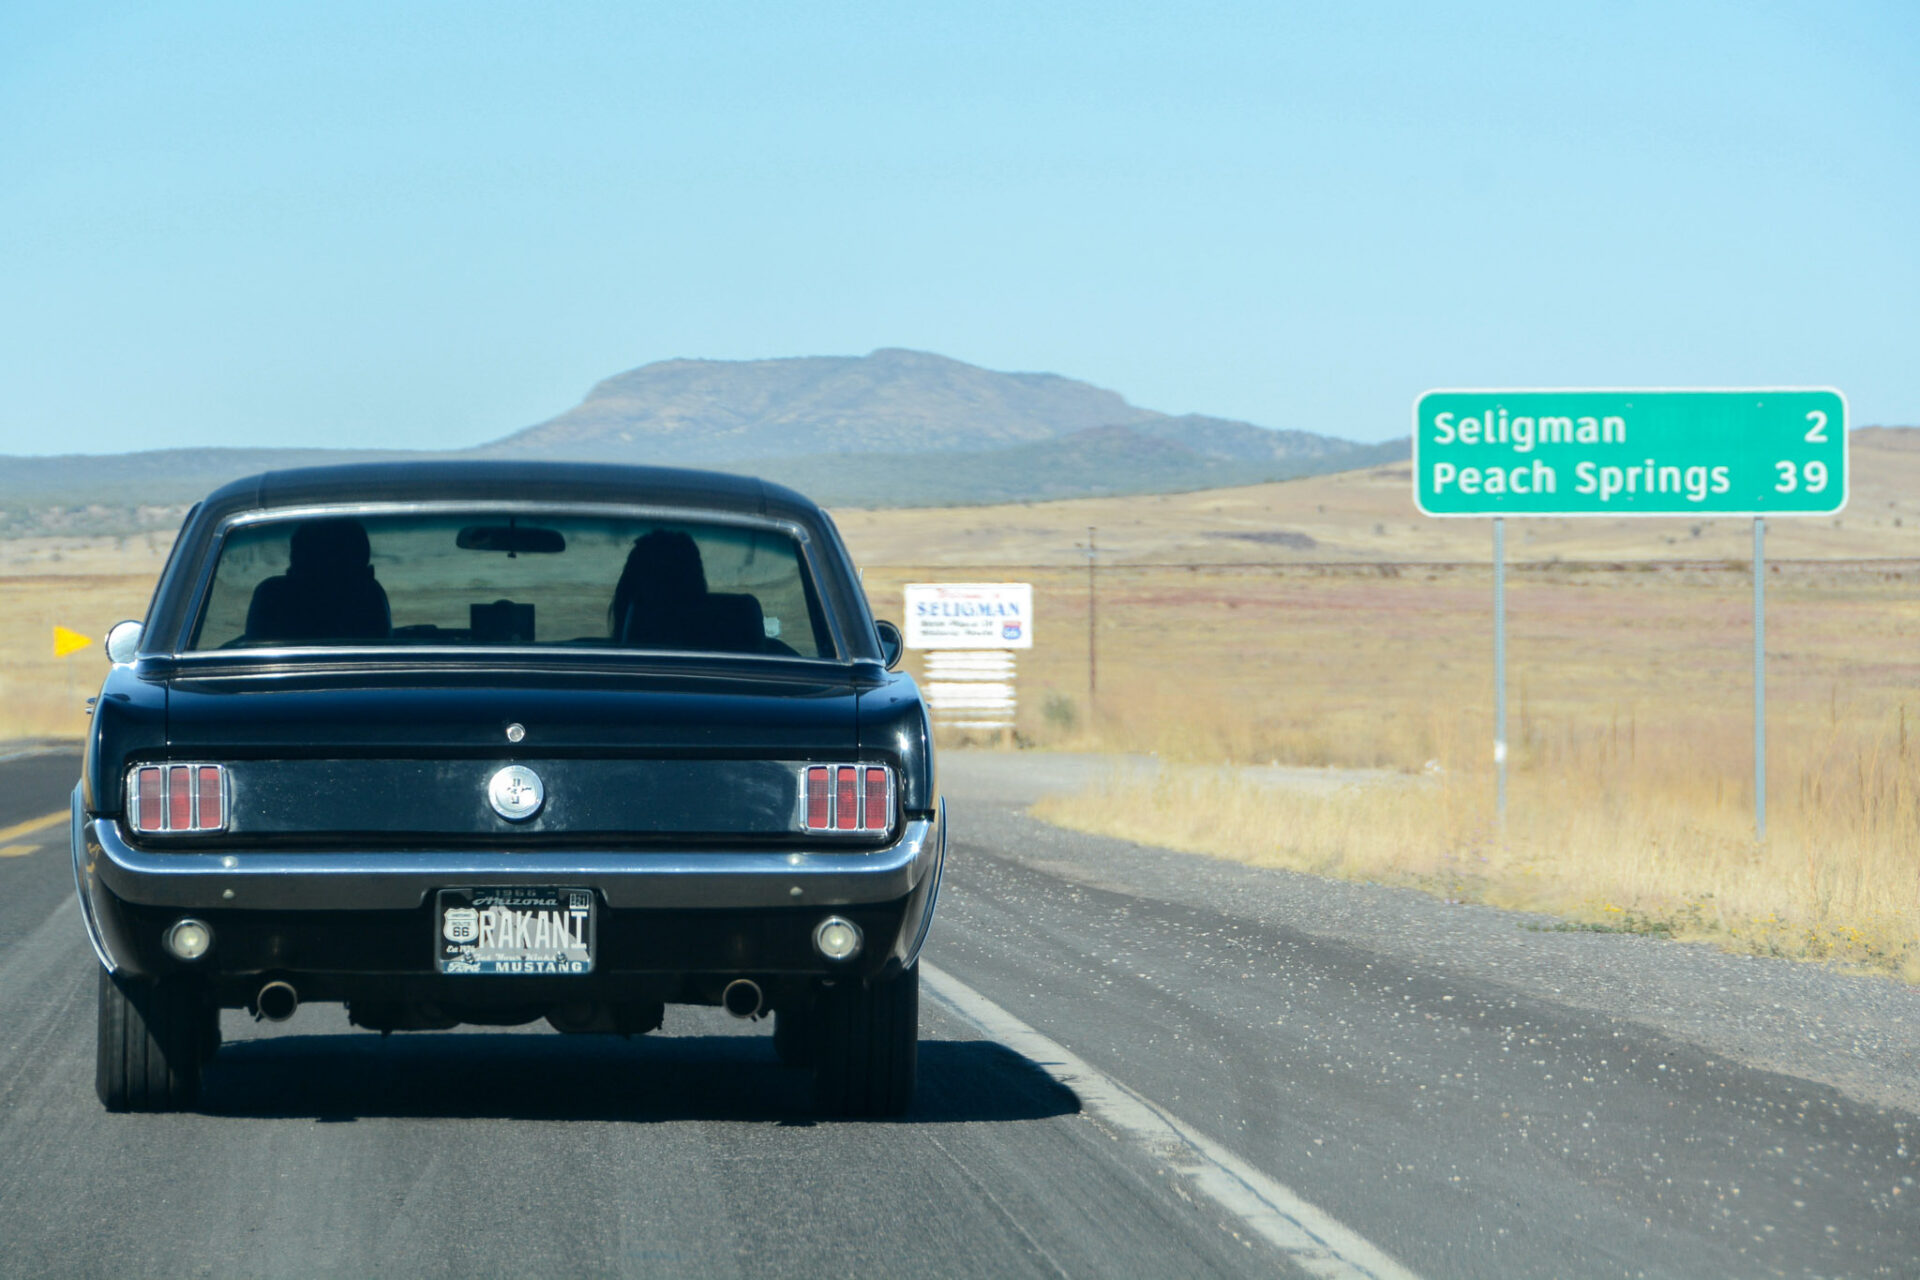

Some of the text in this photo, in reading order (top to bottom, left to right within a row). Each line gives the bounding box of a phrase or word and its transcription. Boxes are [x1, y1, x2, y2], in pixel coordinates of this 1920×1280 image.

[1433, 409, 1829, 452] Seligman 2
[1433, 459, 1829, 502] Peach Springs 39
[916, 601, 1020, 616] SELIGMAN
[472, 896, 558, 906] Arizona
[453, 926, 470, 937] 66
[479, 910, 588, 949] RAKANI
[447, 961, 583, 973] Ford MUSTANG
